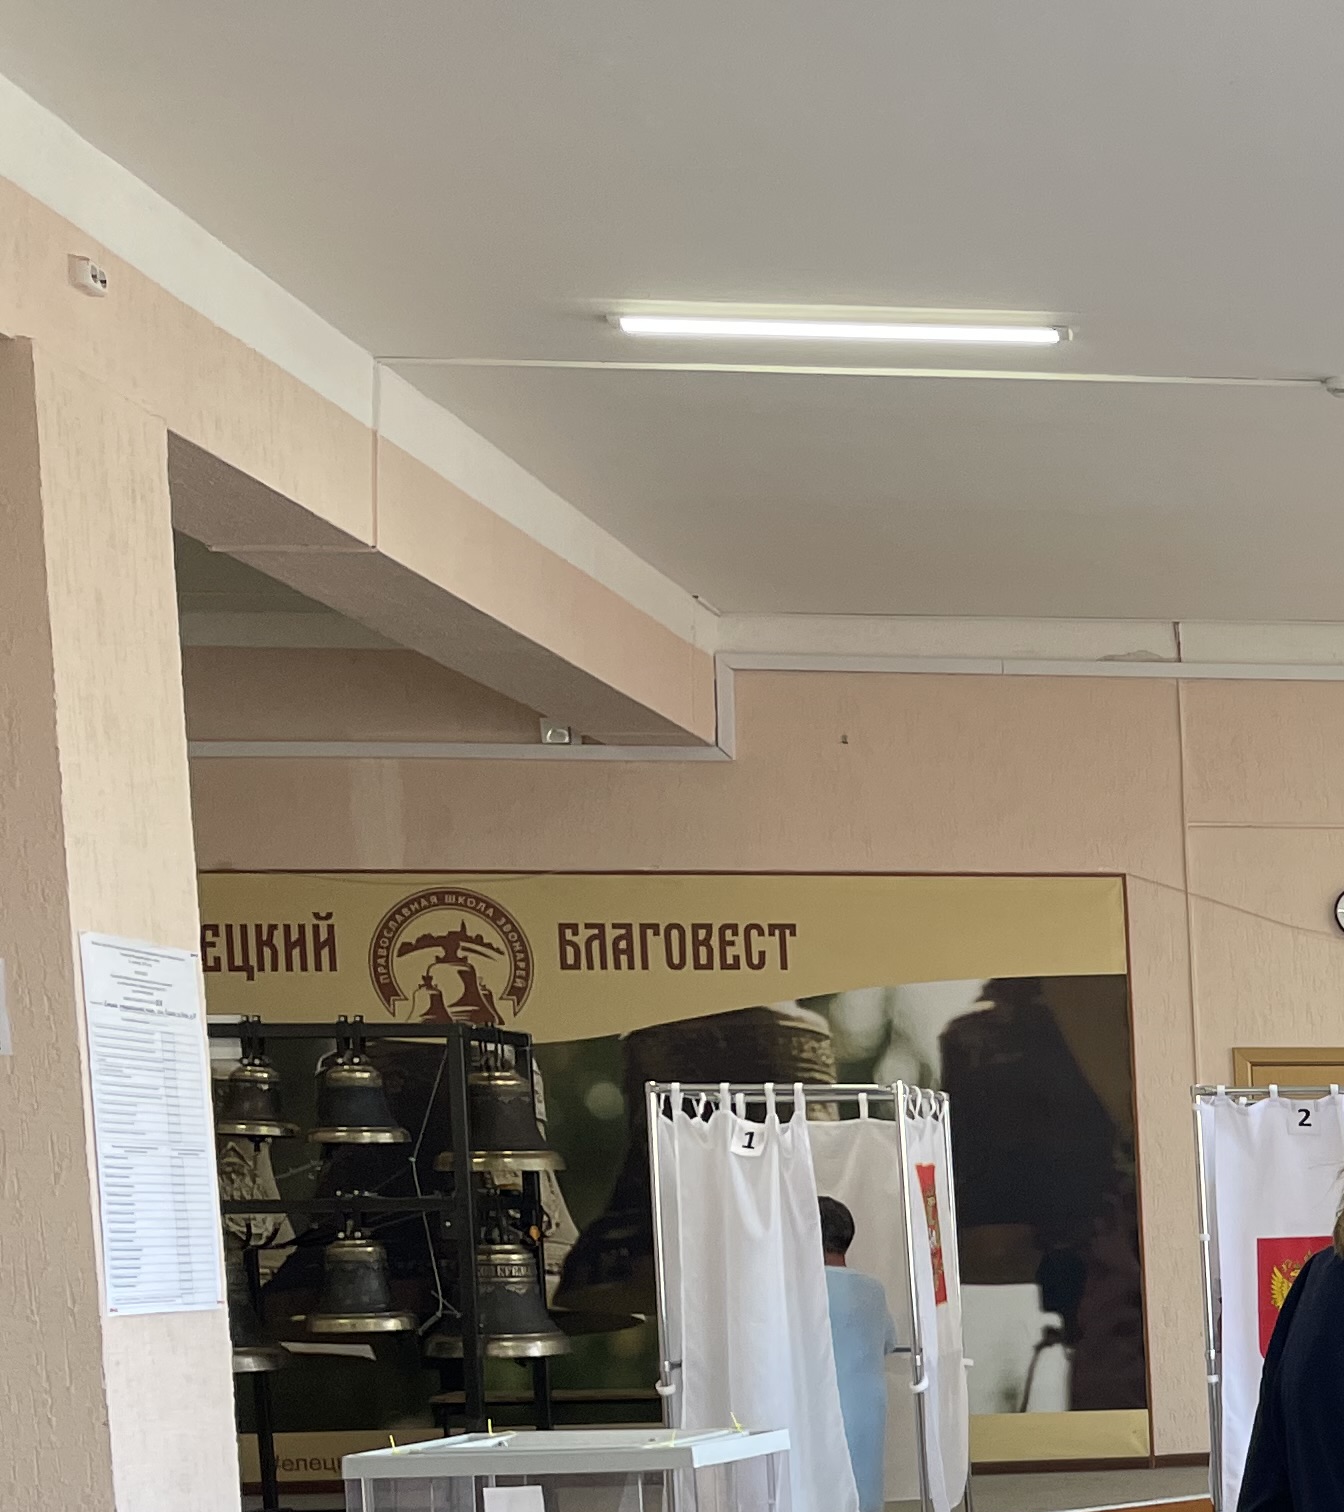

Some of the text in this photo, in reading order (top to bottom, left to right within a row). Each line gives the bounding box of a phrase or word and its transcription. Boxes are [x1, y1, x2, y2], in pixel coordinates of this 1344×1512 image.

[376, 894, 527, 989] ПРАВОСЛАВНАЯ ШКОЛА ЗВОНАРЕЙ
[557, 922, 797, 971] БЛАГОВЕСТ
[1297, 1108, 1313, 1128] 2
[741, 1131, 755, 1150] 1
